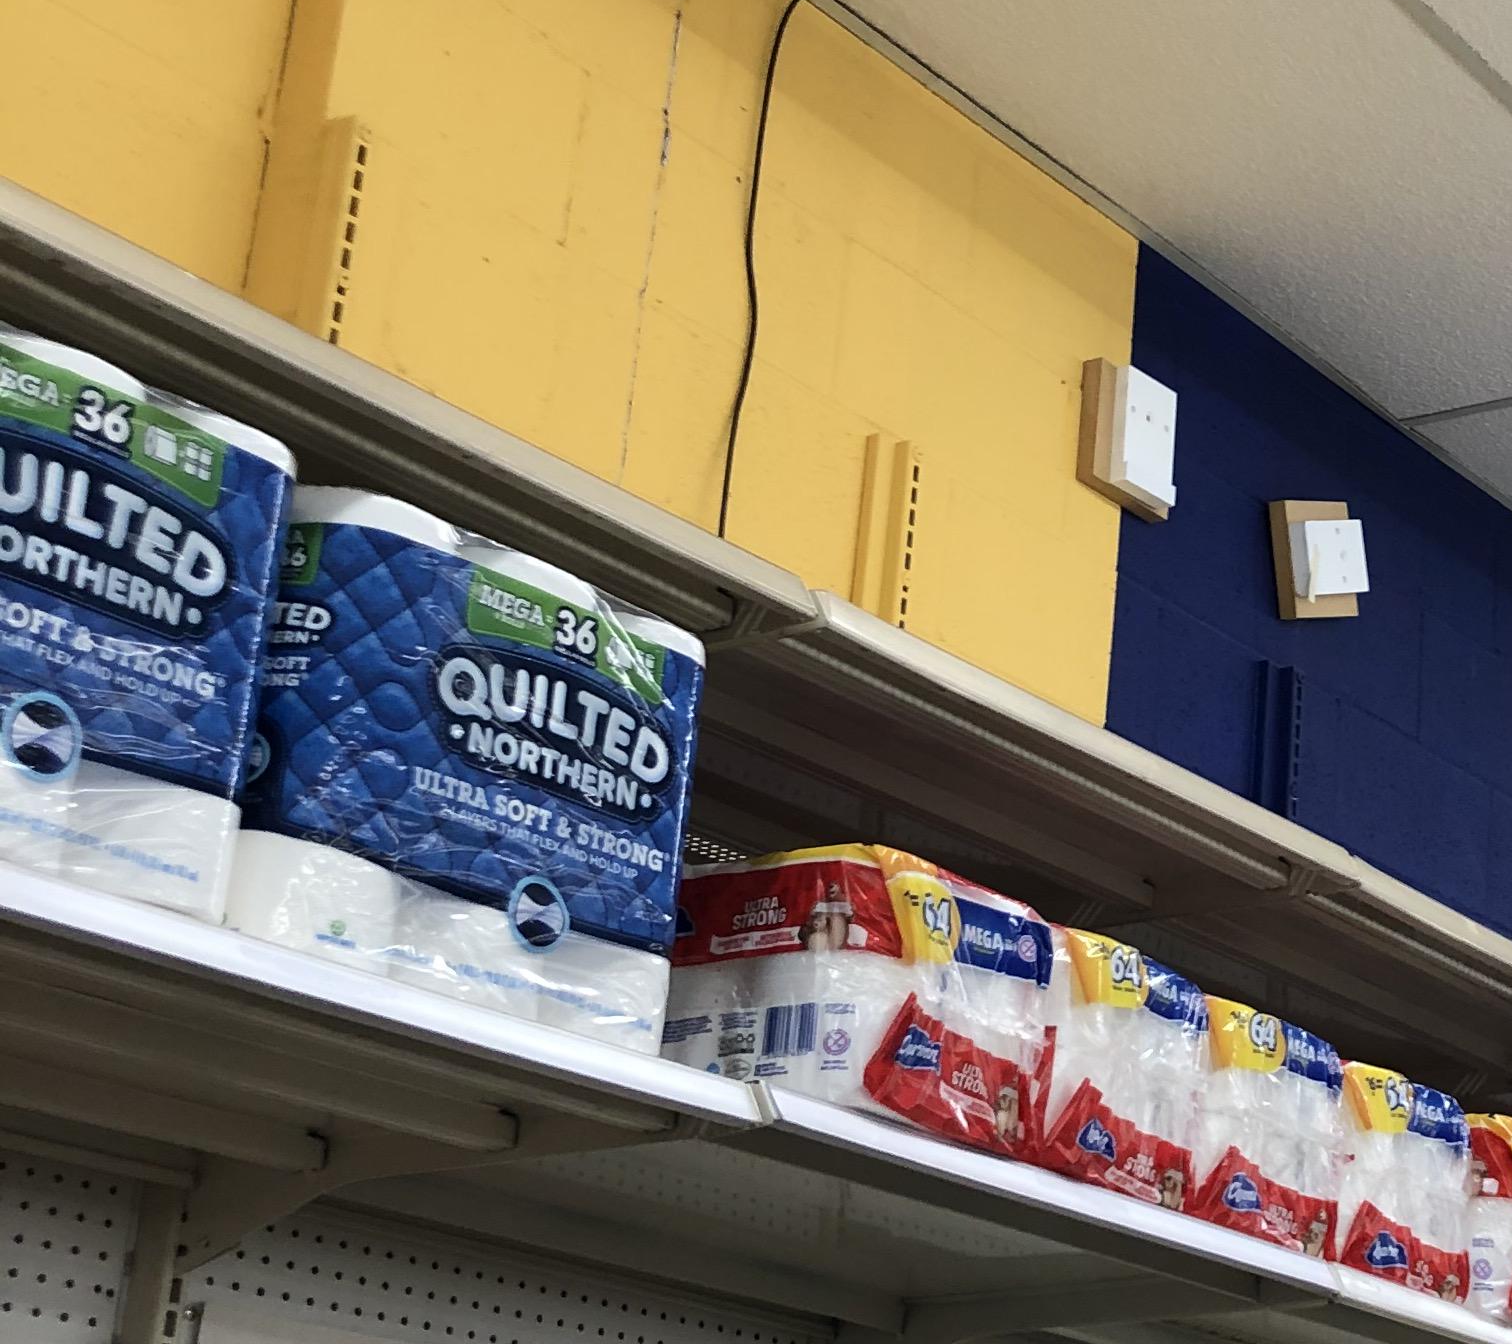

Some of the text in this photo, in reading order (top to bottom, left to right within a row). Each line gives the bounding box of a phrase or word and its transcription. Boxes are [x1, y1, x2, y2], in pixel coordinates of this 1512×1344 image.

[0, 369, 59, 407] EGA
[75, 389, 131, 444] 36
[0, 446, 226, 597] UILTED
[0, 524, 184, 626] ORTHERN
[0, 600, 74, 643] OFT
[477, 584, 545, 628] MEGA
[556, 609, 597, 655] 36
[438, 656, 669, 784] QUILTED
[467, 721, 638, 811] NORTHERN
[414, 766, 665, 872] ULTRA SOFT & STRONG
[731, 908, 788, 931] STRONG
[962, 923, 1003, 950] MEGA
[1110, 946, 1143, 988] 64
[1250, 1011, 1279, 1053] 64
